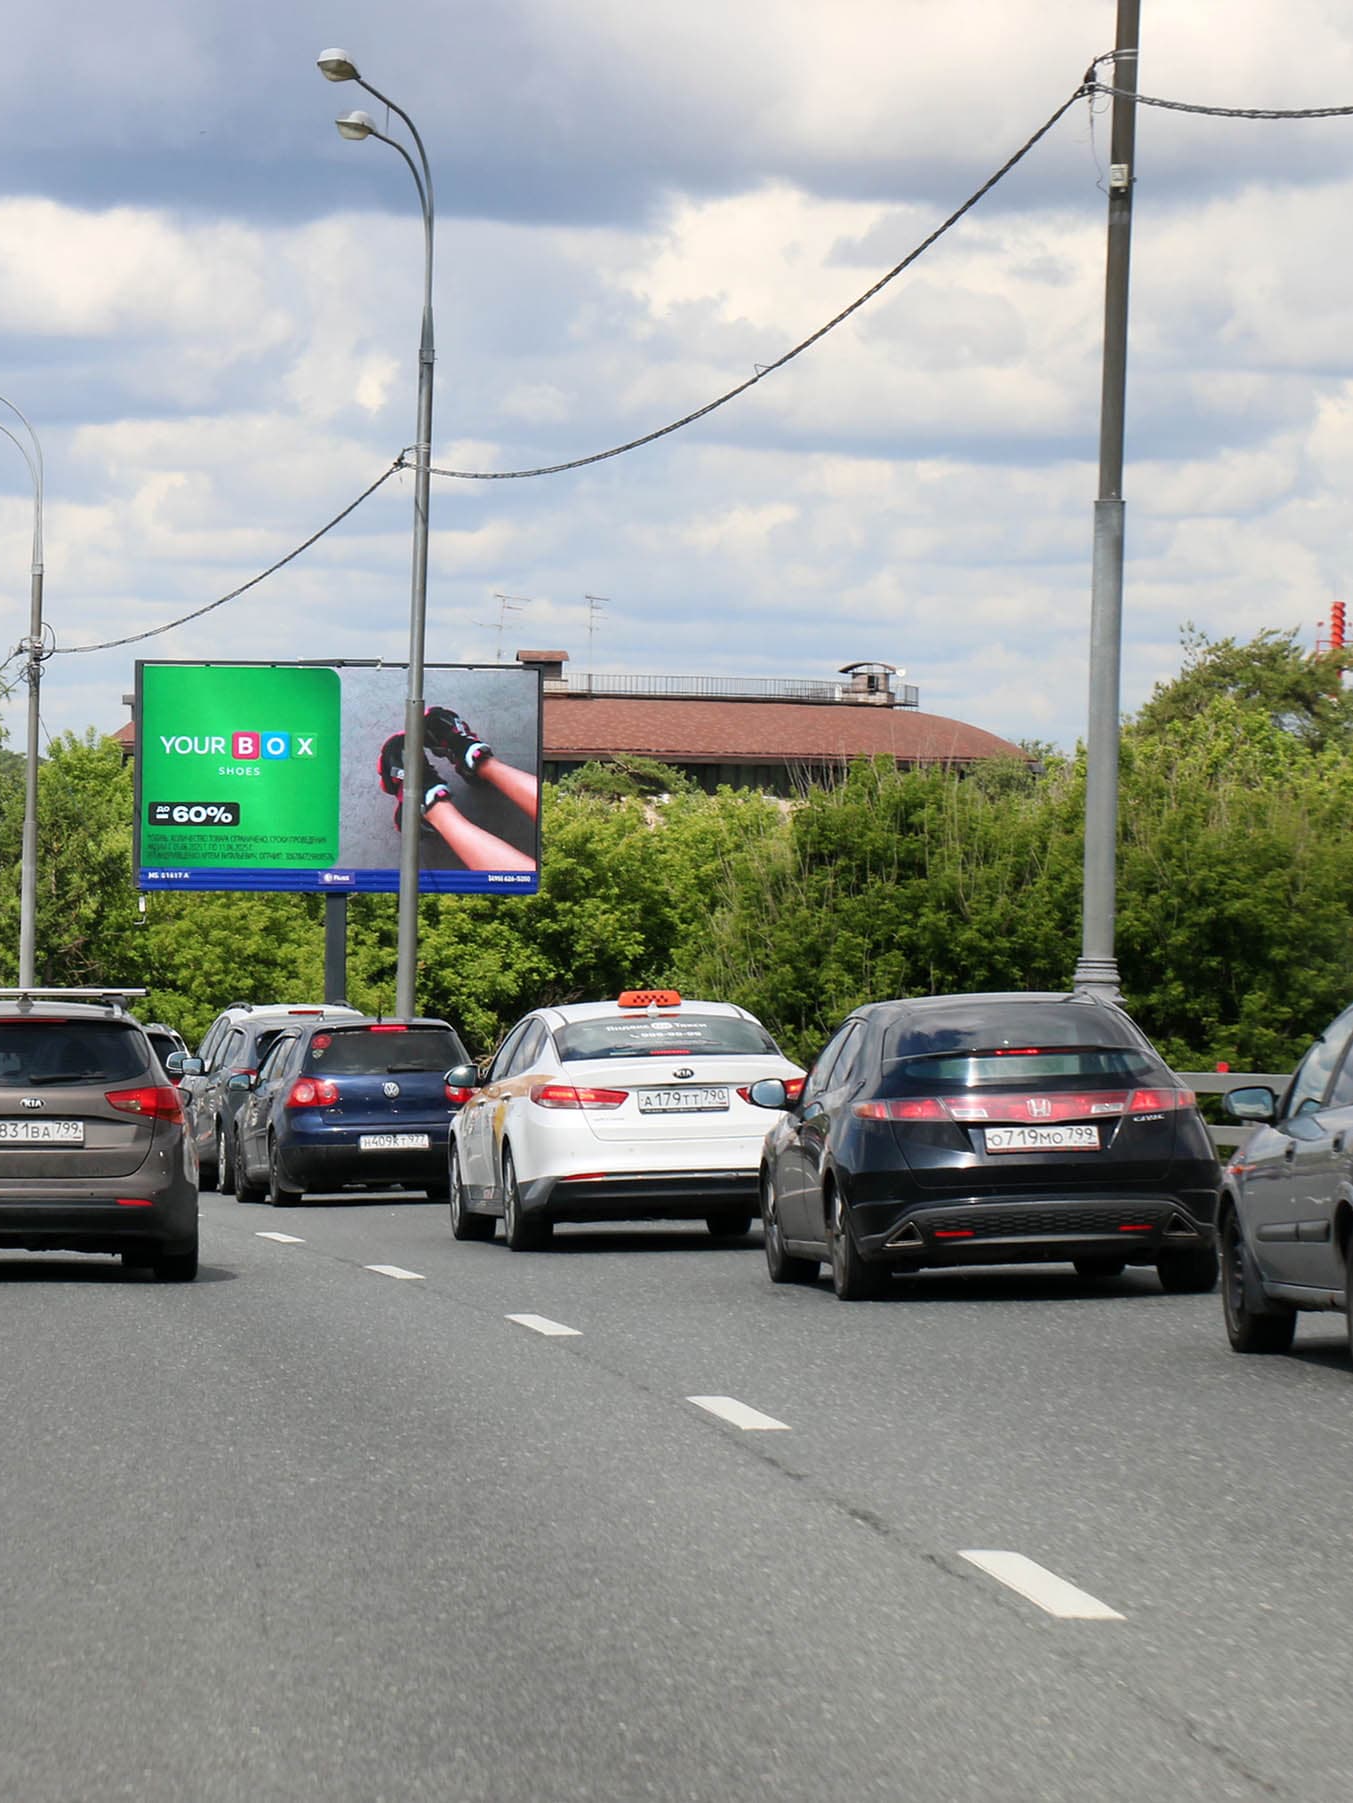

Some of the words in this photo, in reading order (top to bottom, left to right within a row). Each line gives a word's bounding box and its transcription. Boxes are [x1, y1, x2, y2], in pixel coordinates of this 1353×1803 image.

[160, 736, 226, 754] YOUR
[238, 737, 313, 755] BOX
[218, 767, 261, 776] SHOES
[22, 1098, 43, 1107] KIA
